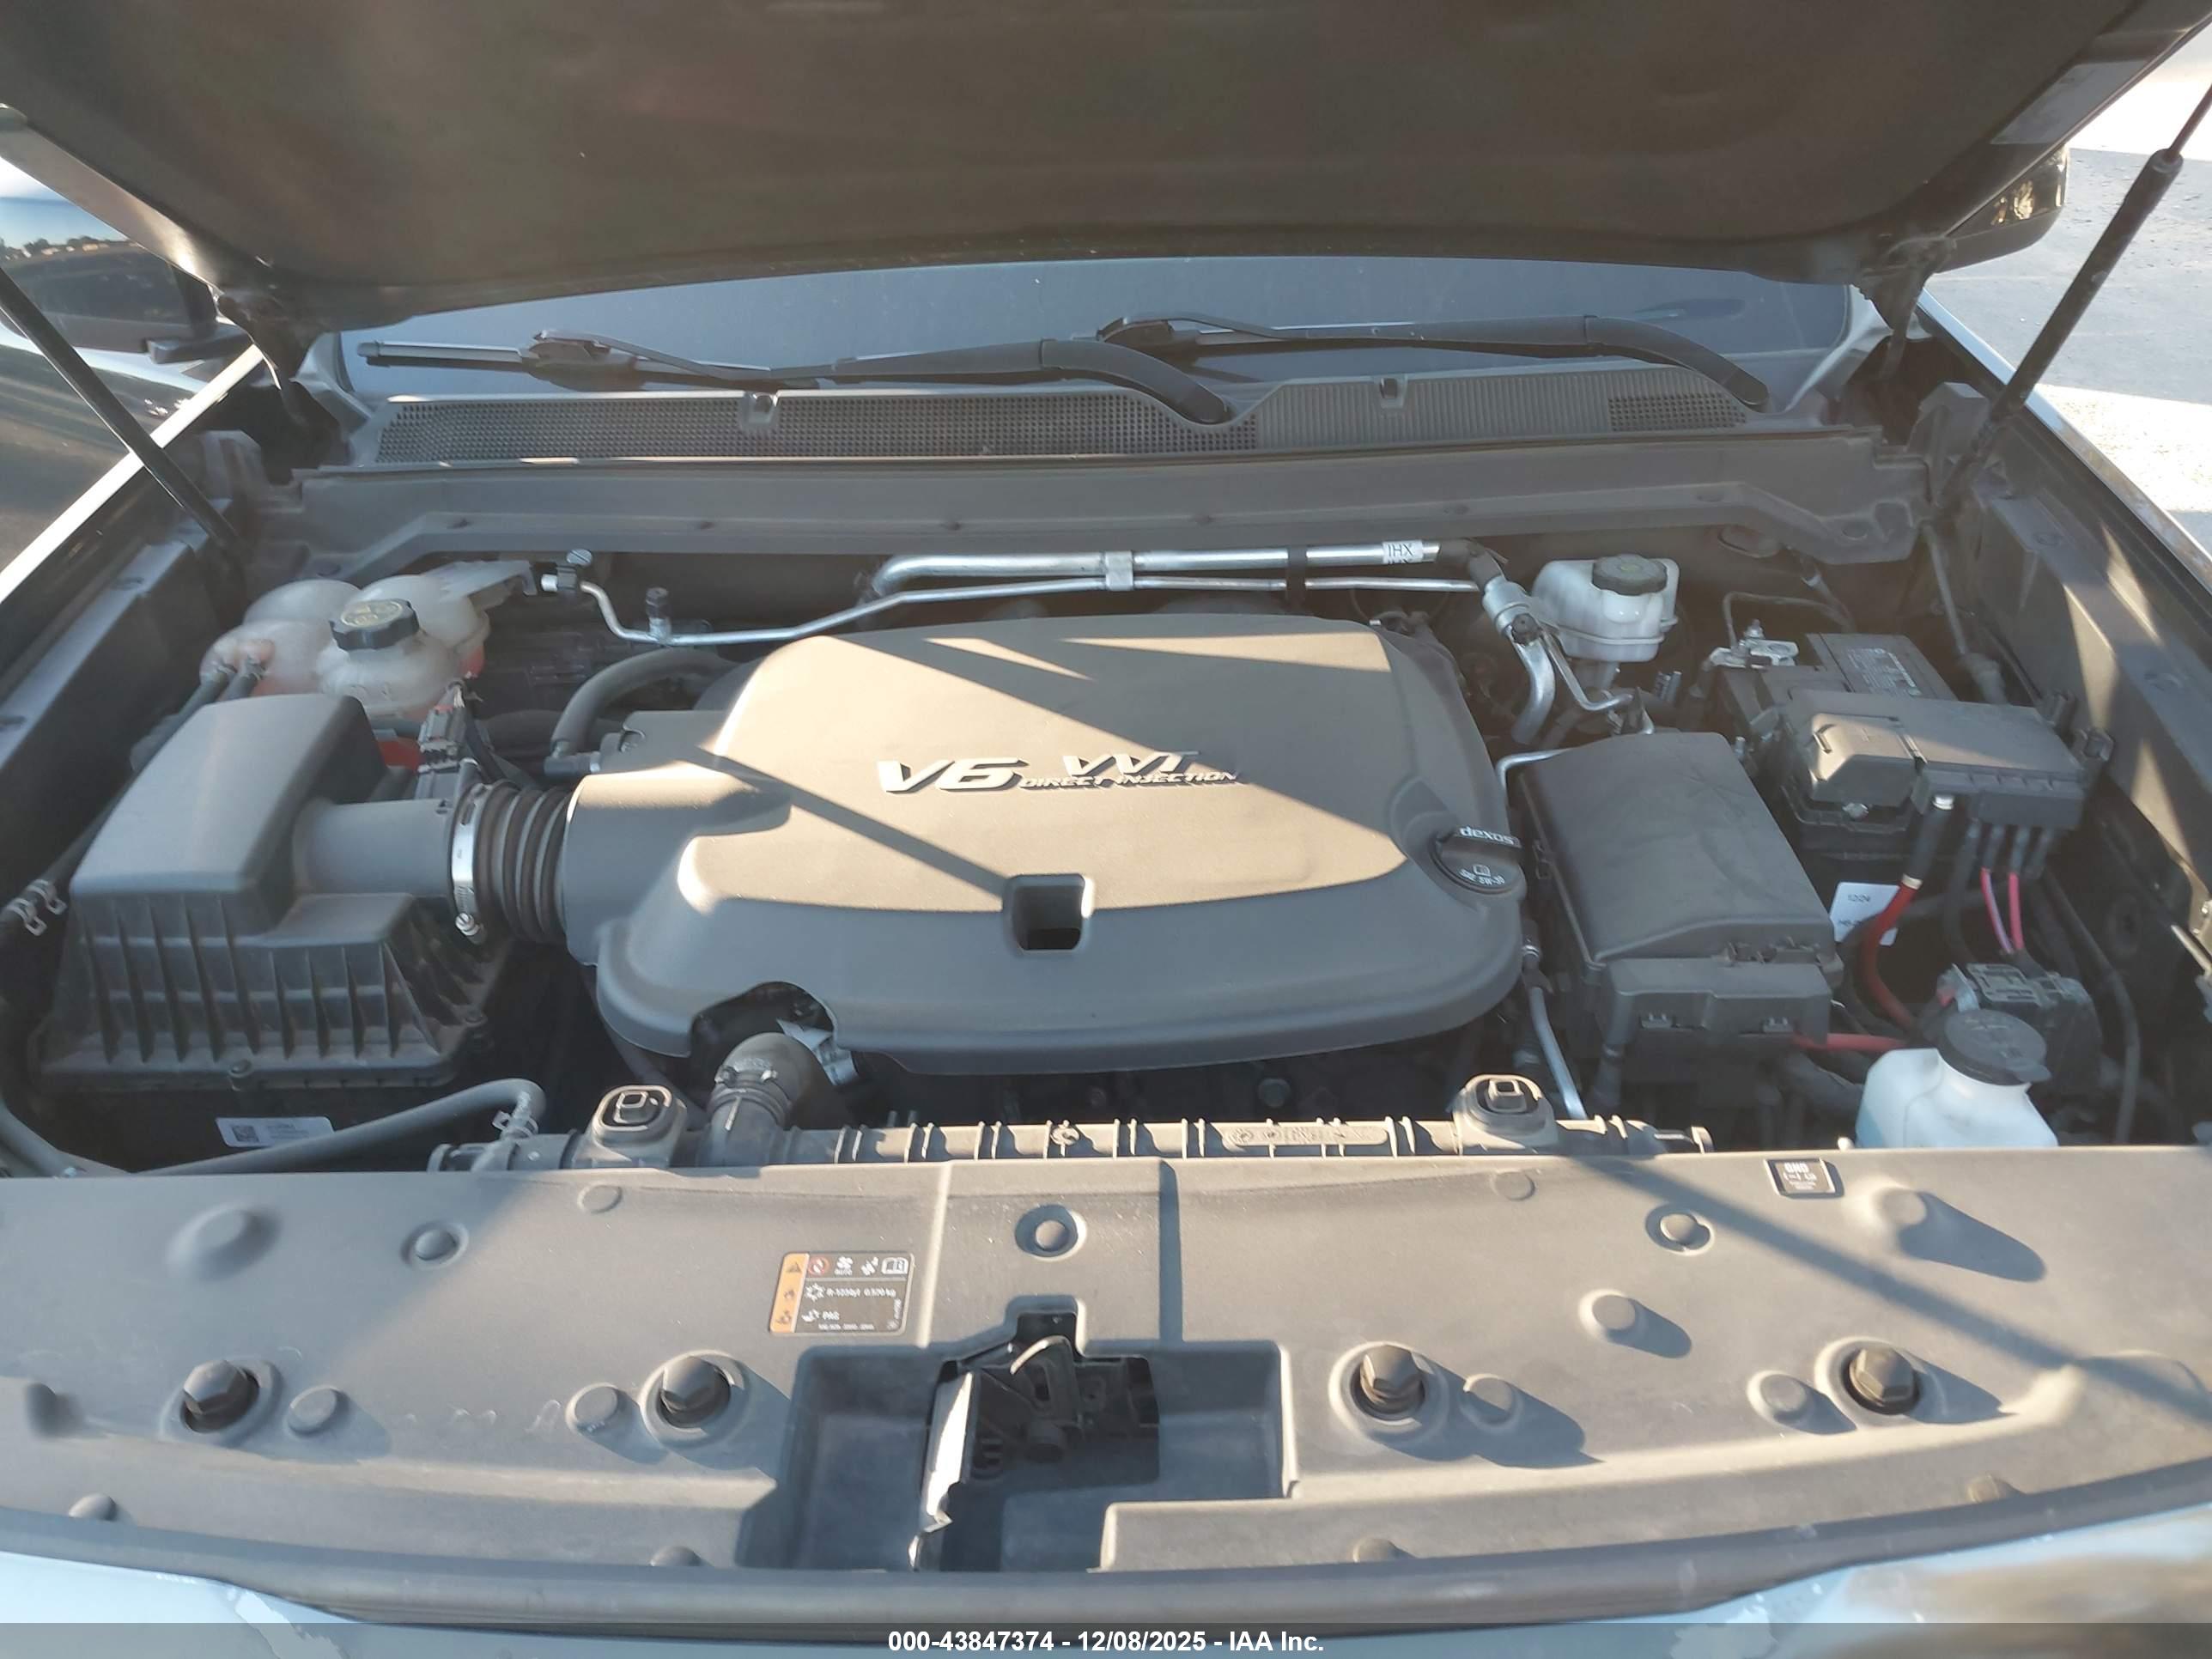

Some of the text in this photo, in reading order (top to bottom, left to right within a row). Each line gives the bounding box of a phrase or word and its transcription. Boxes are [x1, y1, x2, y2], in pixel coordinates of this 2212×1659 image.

[1388, 544, 1413, 556] IHX
[1062, 750, 1201, 775] VVT
[877, 757, 1027, 793] V6
[1020, 771, 1239, 788] DIRECT INJECTION
[1460, 826, 1515, 845] dexos
